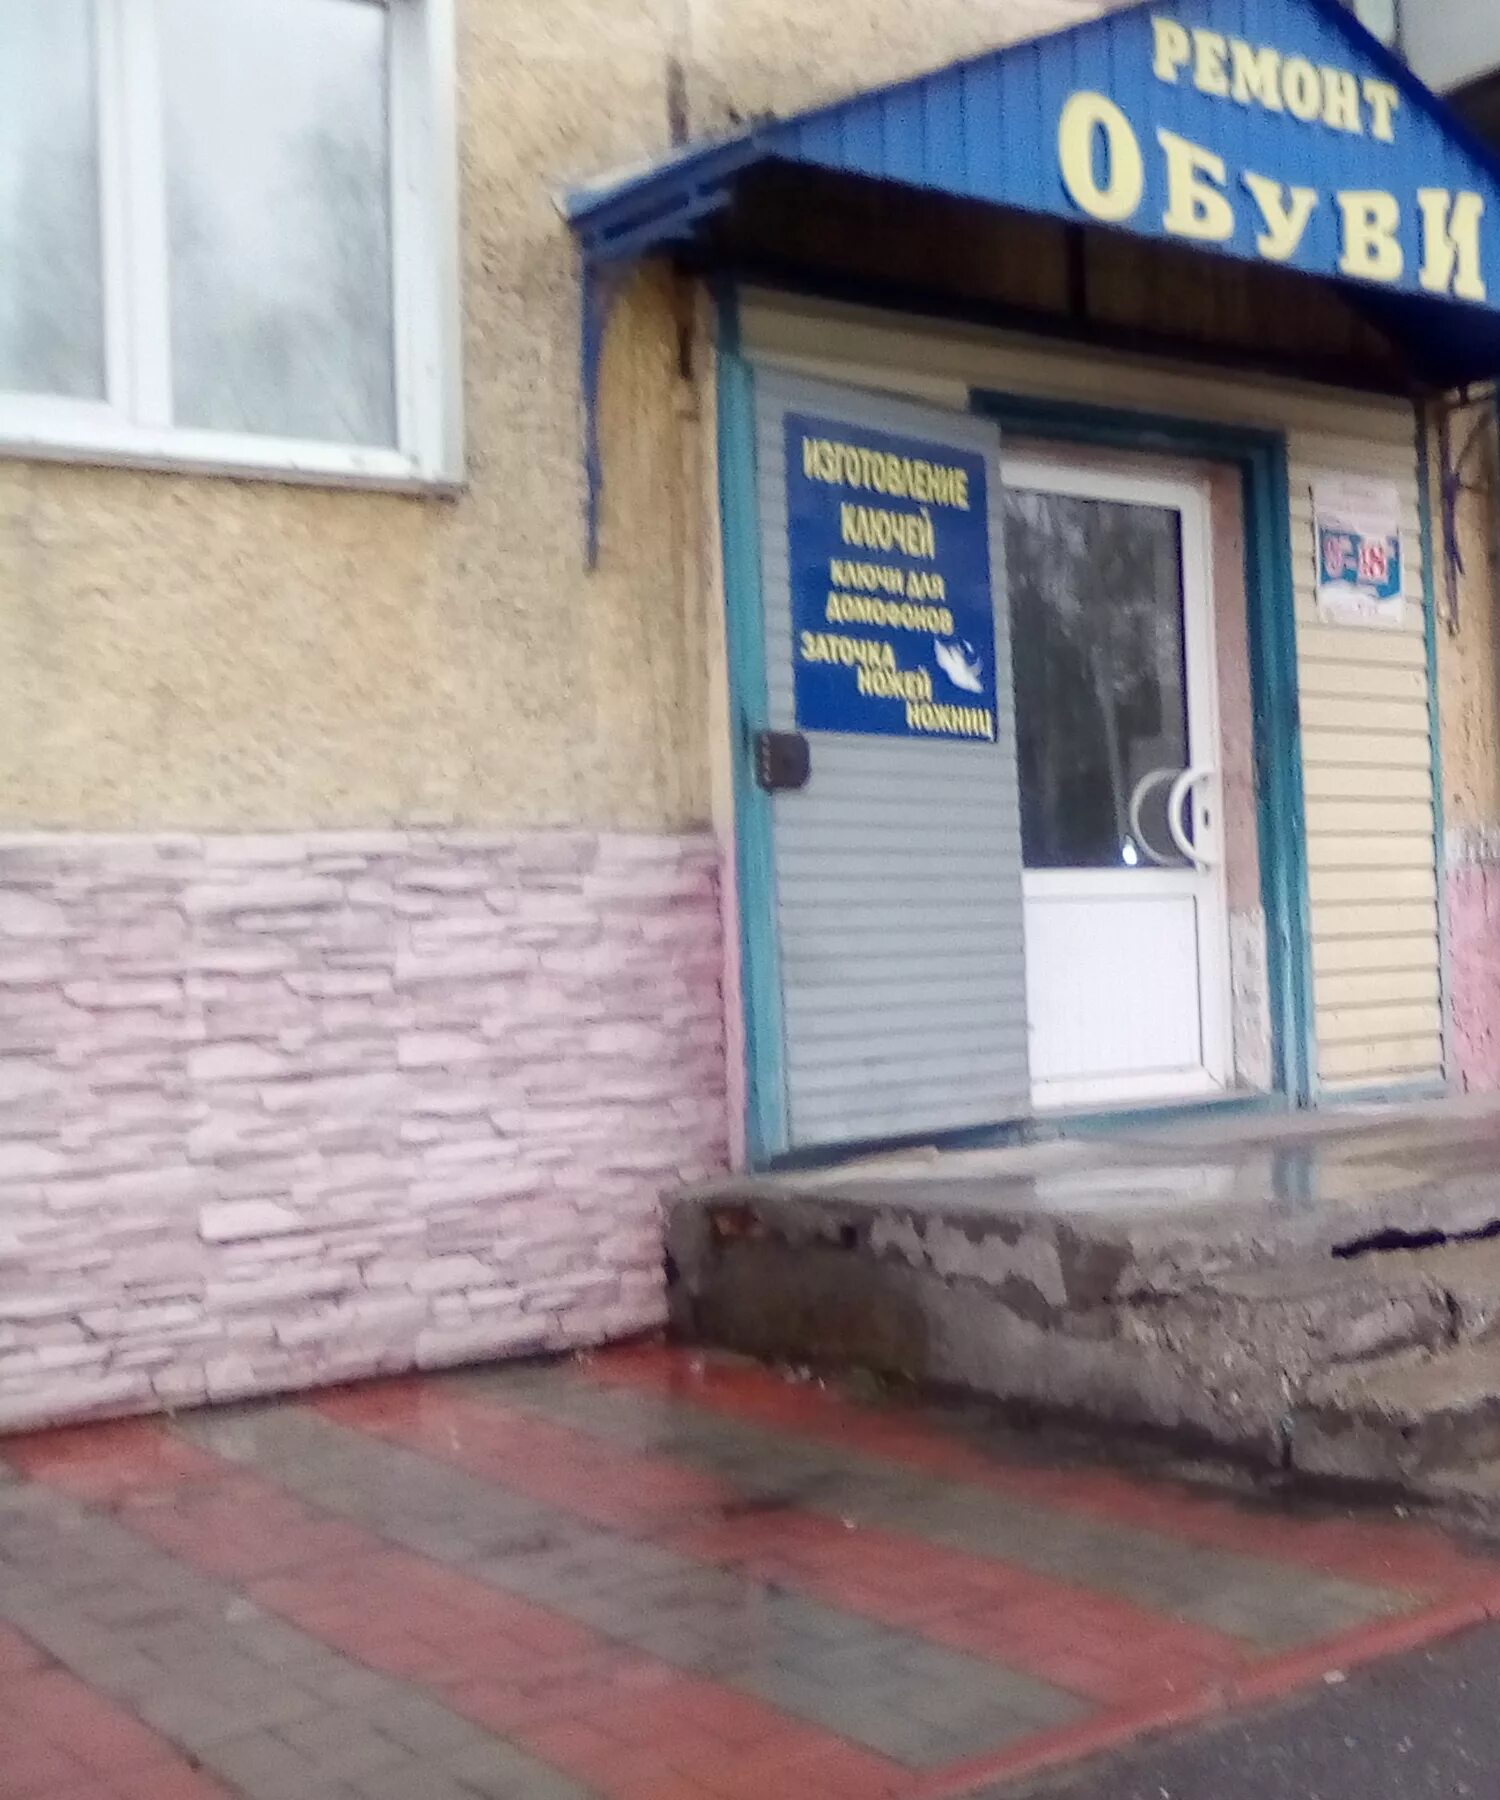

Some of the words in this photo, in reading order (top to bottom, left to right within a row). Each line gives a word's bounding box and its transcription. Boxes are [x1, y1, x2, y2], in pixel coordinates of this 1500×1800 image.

[1151, 15, 1399, 143] РЕМОНТ
[1058, 90, 1486, 301] ОБУВИ
[803, 436, 970, 511] ИЗГОТОВЛЕНИЕ
[840, 501, 935, 560] КЛЮЧЕЙ
[830, 559, 904, 595] КЛЮЧИ
[906, 571, 945, 600] ДЛЯ
[825, 591, 953, 636] ДОМОФОНОВ
[801, 630, 896, 671] ЗАТОЧКА
[857, 664, 933, 701] НОЖЕЙ
[905, 701, 995, 741] НОЖНИЦ
